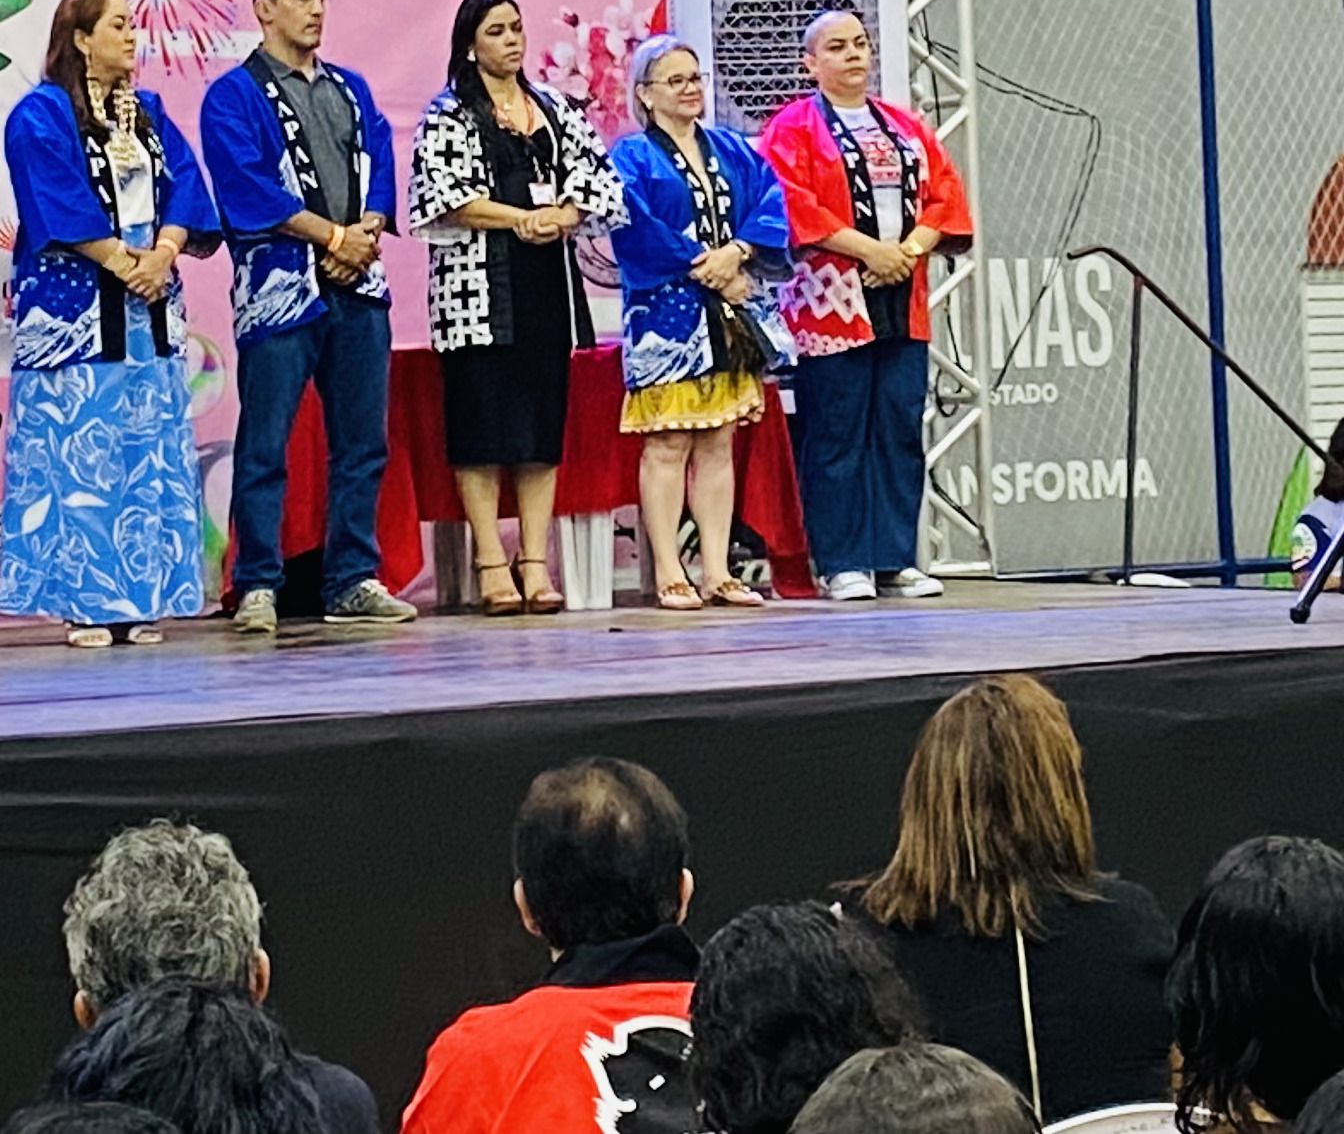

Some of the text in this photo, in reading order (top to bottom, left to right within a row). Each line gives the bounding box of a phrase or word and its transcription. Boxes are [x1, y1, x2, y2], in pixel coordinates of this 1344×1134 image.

[265, 81, 319, 191] JAPAN
[707, 156, 733, 240] JAPA
[989, 383, 1059, 407] STADO
